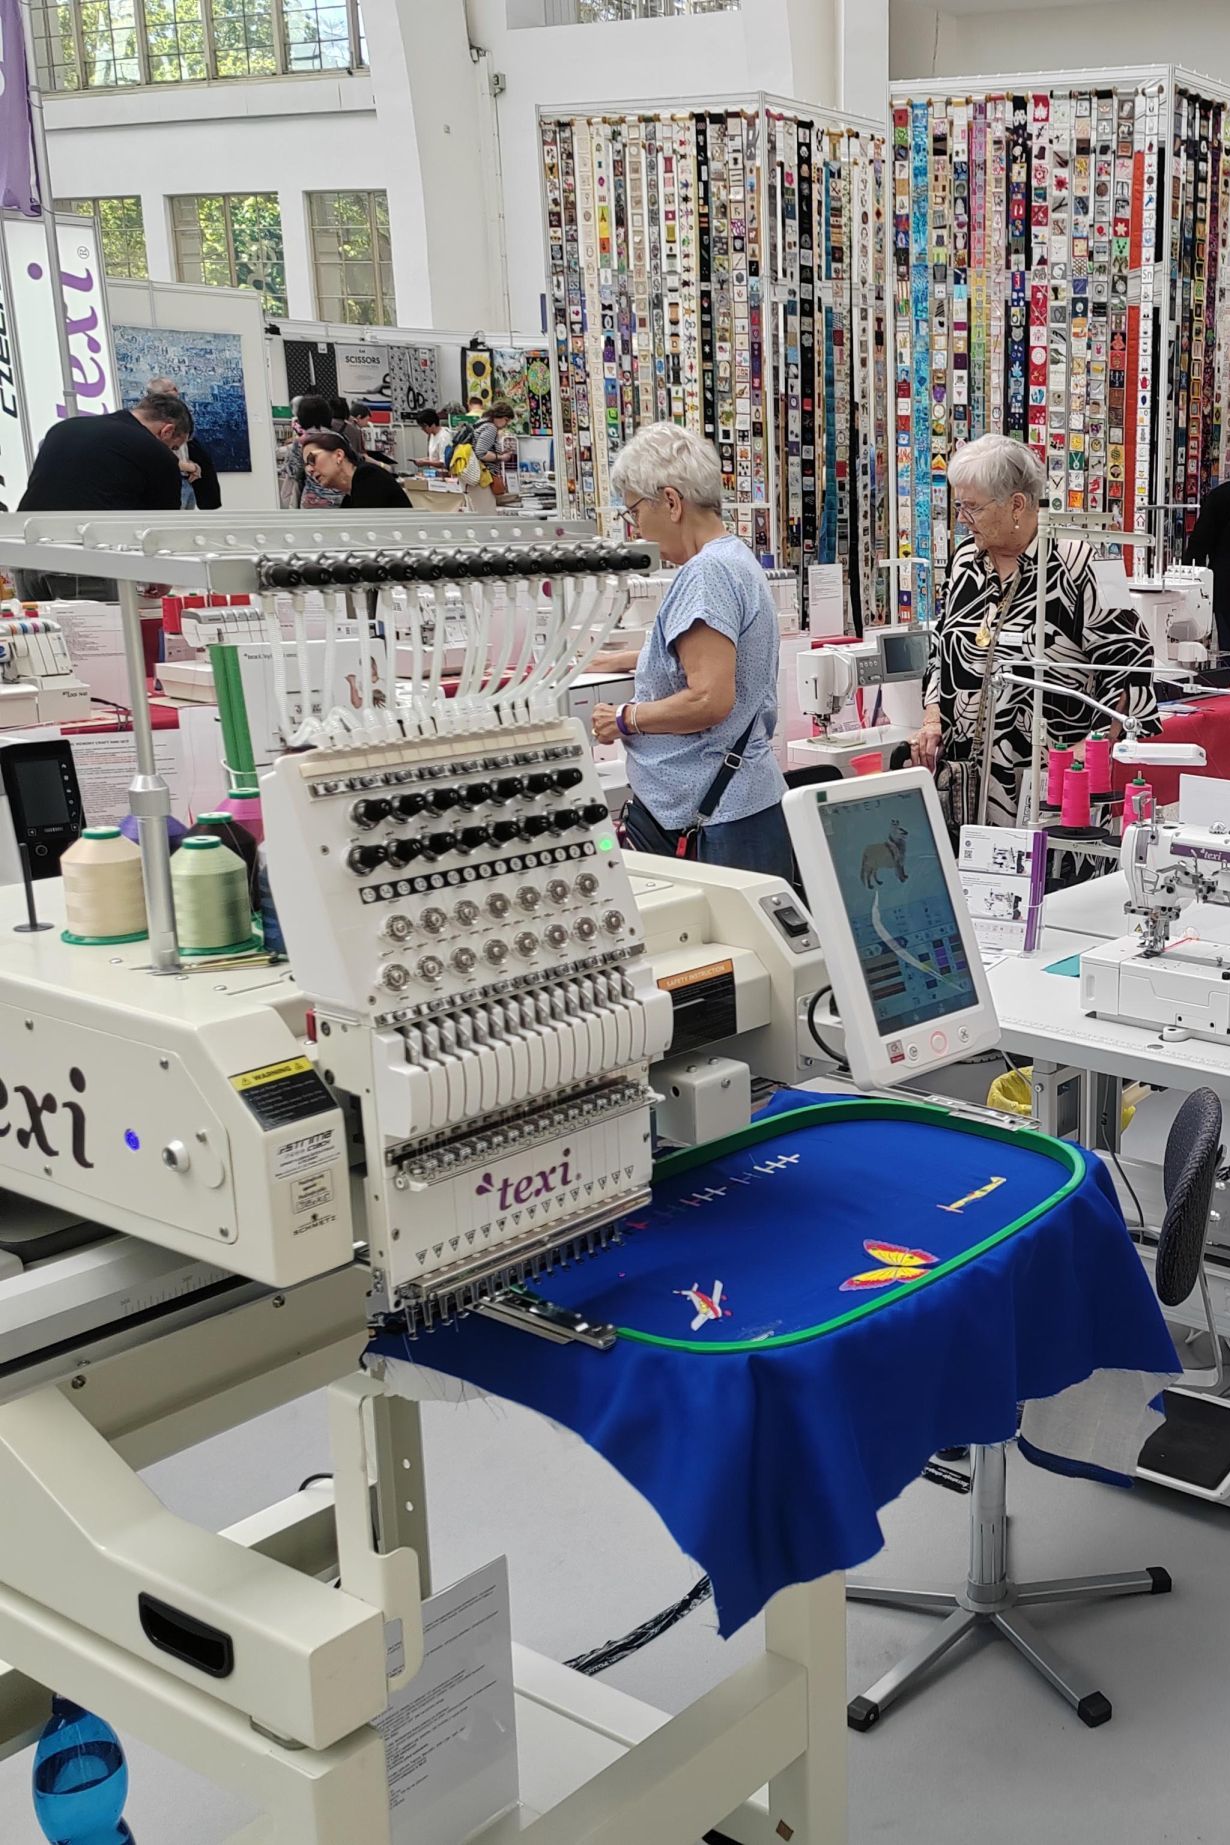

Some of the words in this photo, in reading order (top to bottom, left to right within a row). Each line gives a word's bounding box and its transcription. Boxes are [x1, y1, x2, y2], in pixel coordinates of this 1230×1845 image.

[345, 356, 380, 365] SCISSORS
[1204, 851, 1223, 861] texi
[253, 1065, 292, 1081] WARNING
[0, 1066, 94, 1168] xi
[496, 1147, 573, 1211] texi
